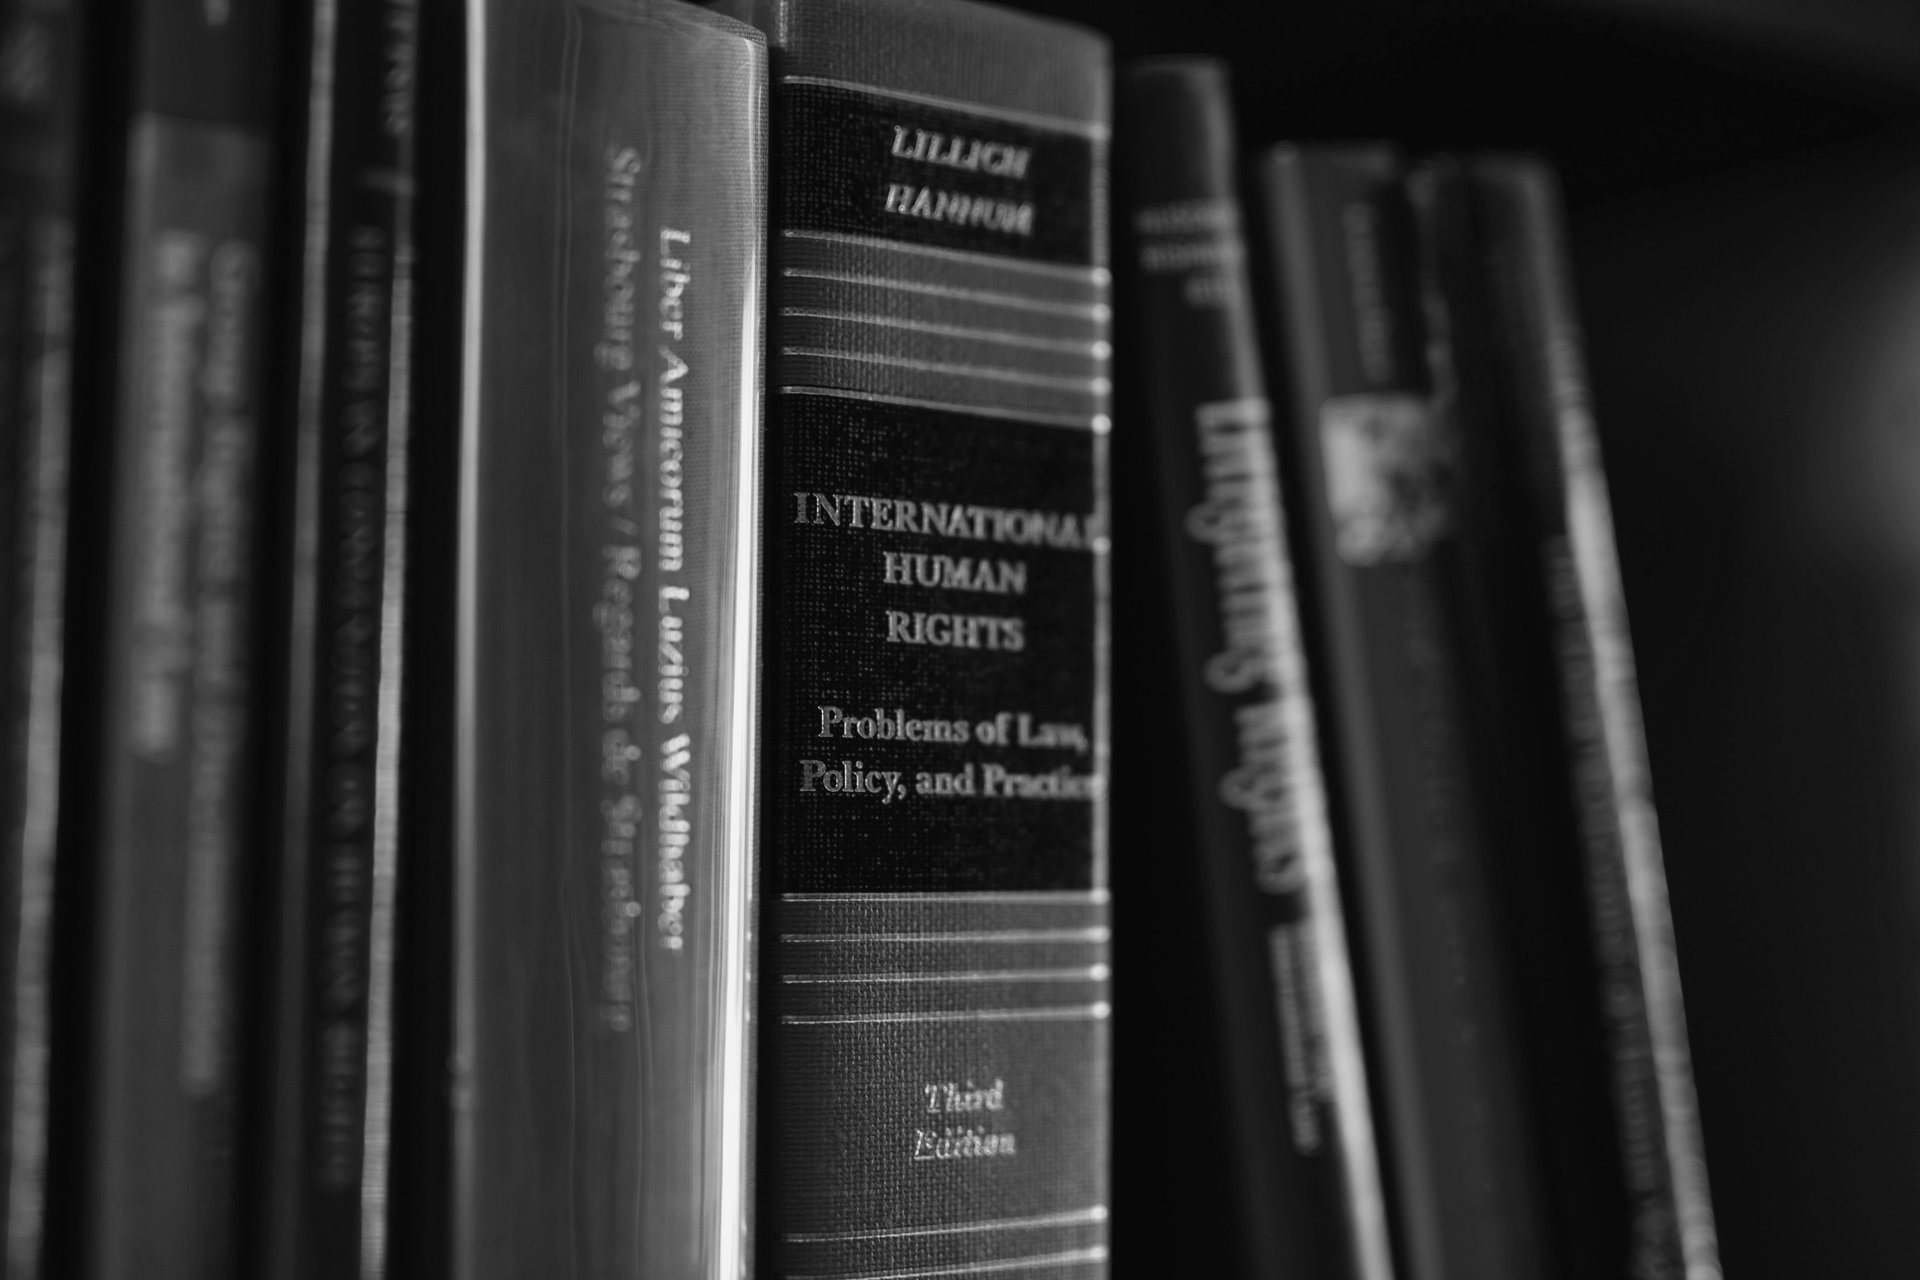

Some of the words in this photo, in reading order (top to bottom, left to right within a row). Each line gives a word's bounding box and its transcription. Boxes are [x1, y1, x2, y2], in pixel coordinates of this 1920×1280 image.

[891, 125, 1031, 179] LILLICH
[885, 183, 1036, 235] HANNUM
[660, 226, 691, 341] Liber
[659, 346, 689, 572] Amicorum
[883, 550, 1027, 594] HUMAN
[886, 609, 1026, 651] RIGHTS
[658, 586, 690, 725] Luzius
[817, 705, 970, 743] Problems
[974, 711, 1013, 745] of
[800, 759, 907, 804] Policy,
[915, 763, 976, 796] and
[658, 732, 692, 955] Wildhaber
[925, 1078, 1005, 1113] Third
[913, 1124, 1017, 1160] Edition
